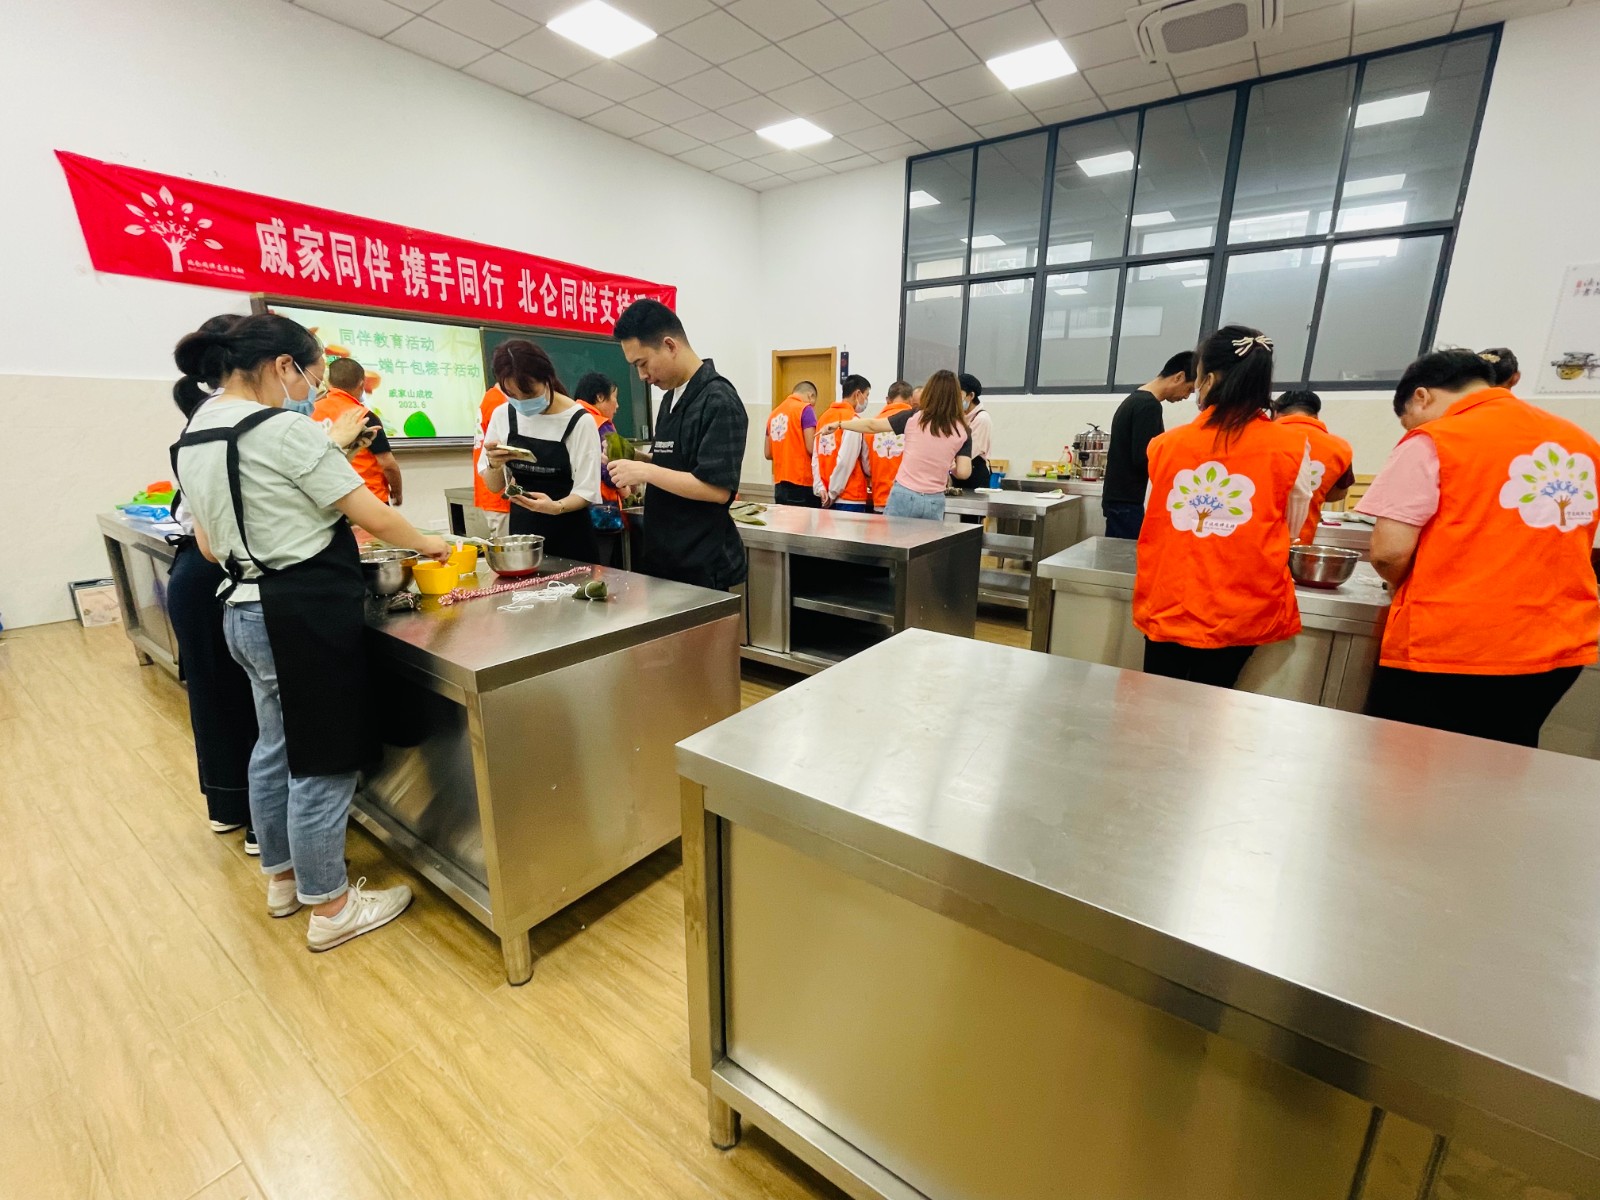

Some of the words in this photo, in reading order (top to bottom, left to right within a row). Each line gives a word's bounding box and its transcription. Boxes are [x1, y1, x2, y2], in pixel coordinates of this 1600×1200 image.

[256, 217, 394, 293] 戚家同伴
[400, 244, 505, 309] 携手同行
[518, 268, 661, 326] 北仑同伴支持
[340, 328, 434, 351] 同伴教育活动
